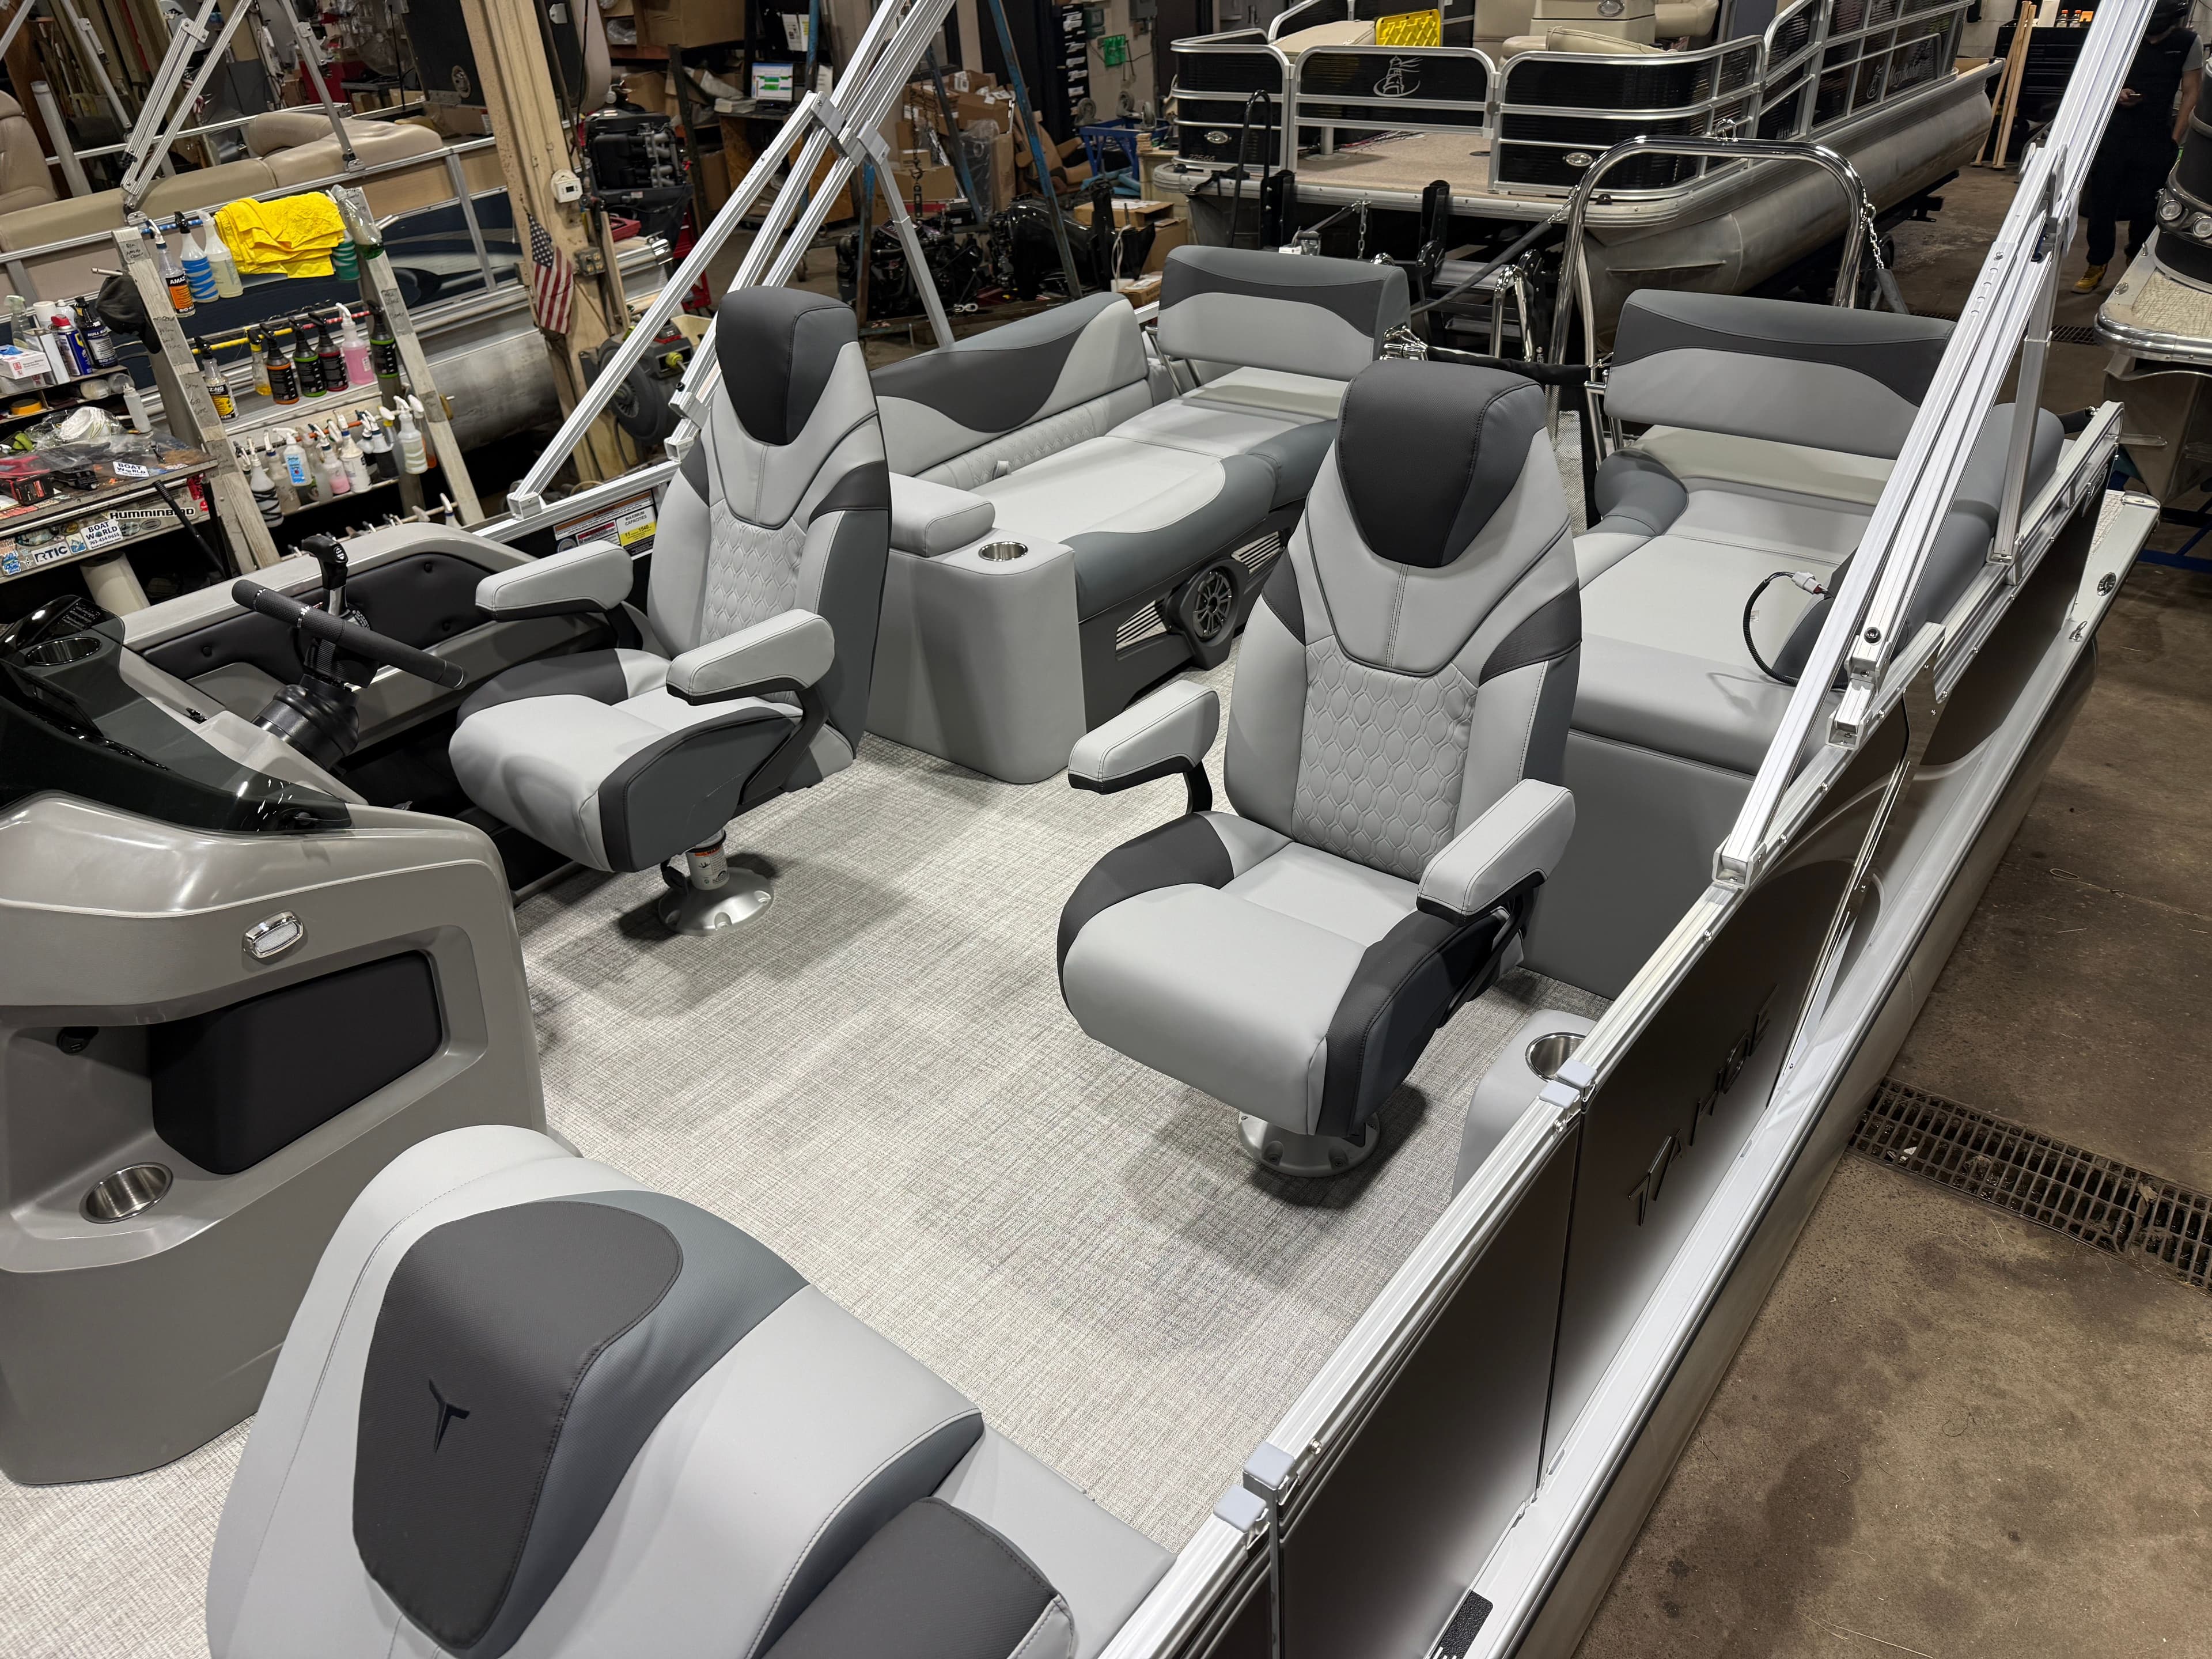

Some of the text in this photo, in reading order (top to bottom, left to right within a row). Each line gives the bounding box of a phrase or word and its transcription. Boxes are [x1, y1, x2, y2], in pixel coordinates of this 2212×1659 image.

[110, 508, 195, 519] HUMMINBD
[625, 511, 645, 521] MAXIMUM
[625, 515, 647, 526] CAPACITIES
[88, 521, 109, 533] BOAT
[35, 546, 68, 562] RTIC
